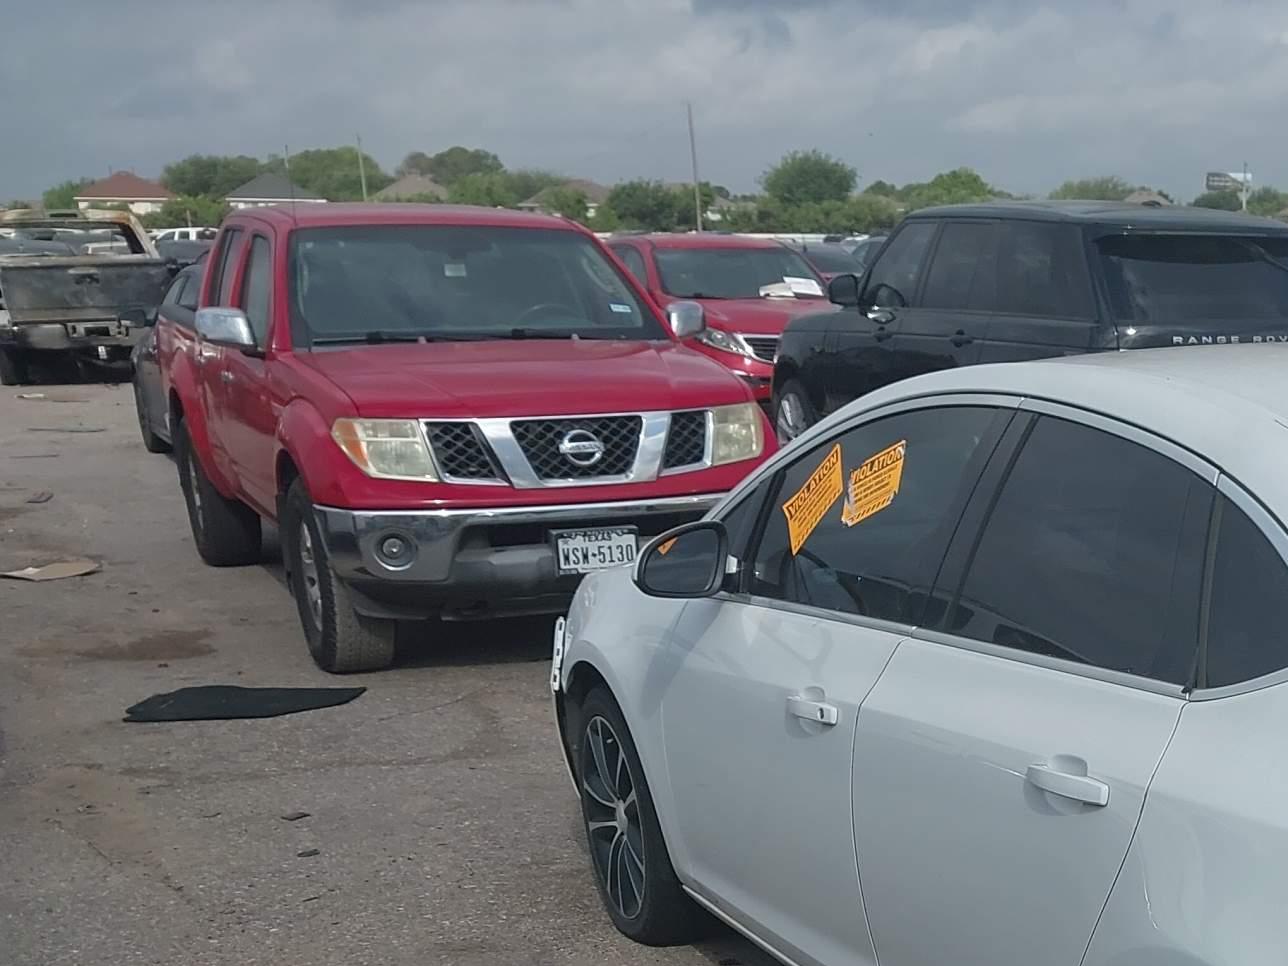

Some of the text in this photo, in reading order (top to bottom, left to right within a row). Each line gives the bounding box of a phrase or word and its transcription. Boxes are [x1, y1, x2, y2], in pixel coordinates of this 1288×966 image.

[1172, 335, 1241, 345] RANGE
[787, 450, 840, 518] VIOLATION
[583, 530, 612, 543] TEXAS
